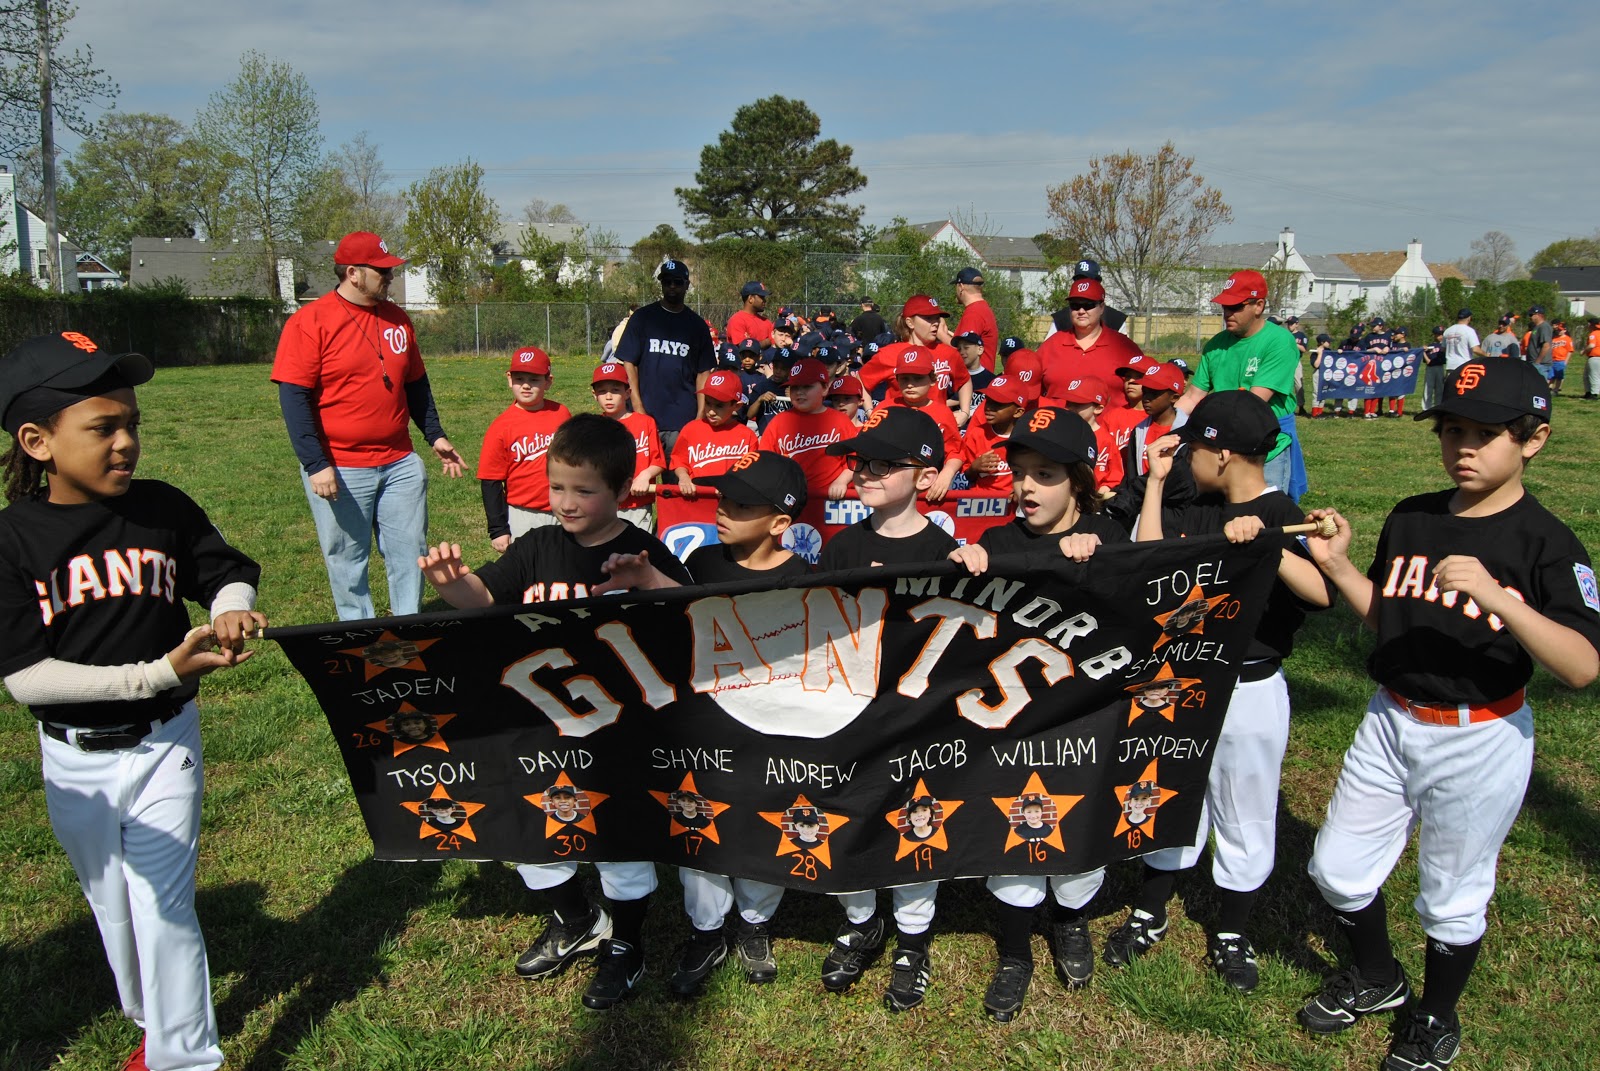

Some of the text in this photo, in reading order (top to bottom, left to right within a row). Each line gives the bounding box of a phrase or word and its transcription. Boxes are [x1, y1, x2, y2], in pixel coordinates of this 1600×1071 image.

[1078, 261, 1090, 272] TB
[1077, 282, 1090, 293] W
[384, 325, 407, 355] W
[649, 338, 690, 358] RAYS
[868, 342, 880, 352] TB
[1005, 338, 1016, 348] TB
[520, 351, 534, 364] W
[904, 350, 918, 364] W
[602, 364, 616, 374] W
[790, 364, 803, 376] W
[1019, 370, 1033, 383] W
[1146, 366, 1160, 376] W
[710, 374, 725, 386] W
[833, 378, 844, 390] W
[992, 377, 1007, 388] W
[1068, 380, 1082, 391] W
[1456, 364, 1486, 396] SF
[862, 408, 889, 432] SF
[1028, 408, 1056, 432] SF
[688, 438, 750, 464] Nationals
[778, 428, 841, 457] Nationals
[732, 452, 760, 472] SF
[825, 500, 874, 524] SPR
[957, 498, 1007, 518] 2013
[1146, 560, 1229, 606] JOEL
[1214, 600, 1241, 620] 20
[894, 577, 1134, 681] MINOR B
[324, 659, 352, 675] 21
[498, 587, 1075, 738] GIANTS
[1124, 640, 1230, 678] SAMUEL
[352, 676, 456, 706] JADEN
[1181, 689, 1206, 709] 29
[352, 732, 382, 749] 26
[991, 736, 1096, 766] WILLIAM
[1118, 734, 1209, 763] JAYDEN
[518, 748, 594, 774] DAVID
[652, 747, 734, 772] SHYNE
[888, 739, 968, 782] JACOB
[387, 762, 476, 788] TYSON
[766, 757, 857, 788] ANDREW
[434, 834, 462, 852] 24
[554, 834, 587, 856] 30
[685, 836, 704, 856] 17
[1127, 829, 1142, 850] 18
[914, 847, 934, 872] 19
[1028, 842, 1047, 864] 16
[790, 852, 818, 881] 28
